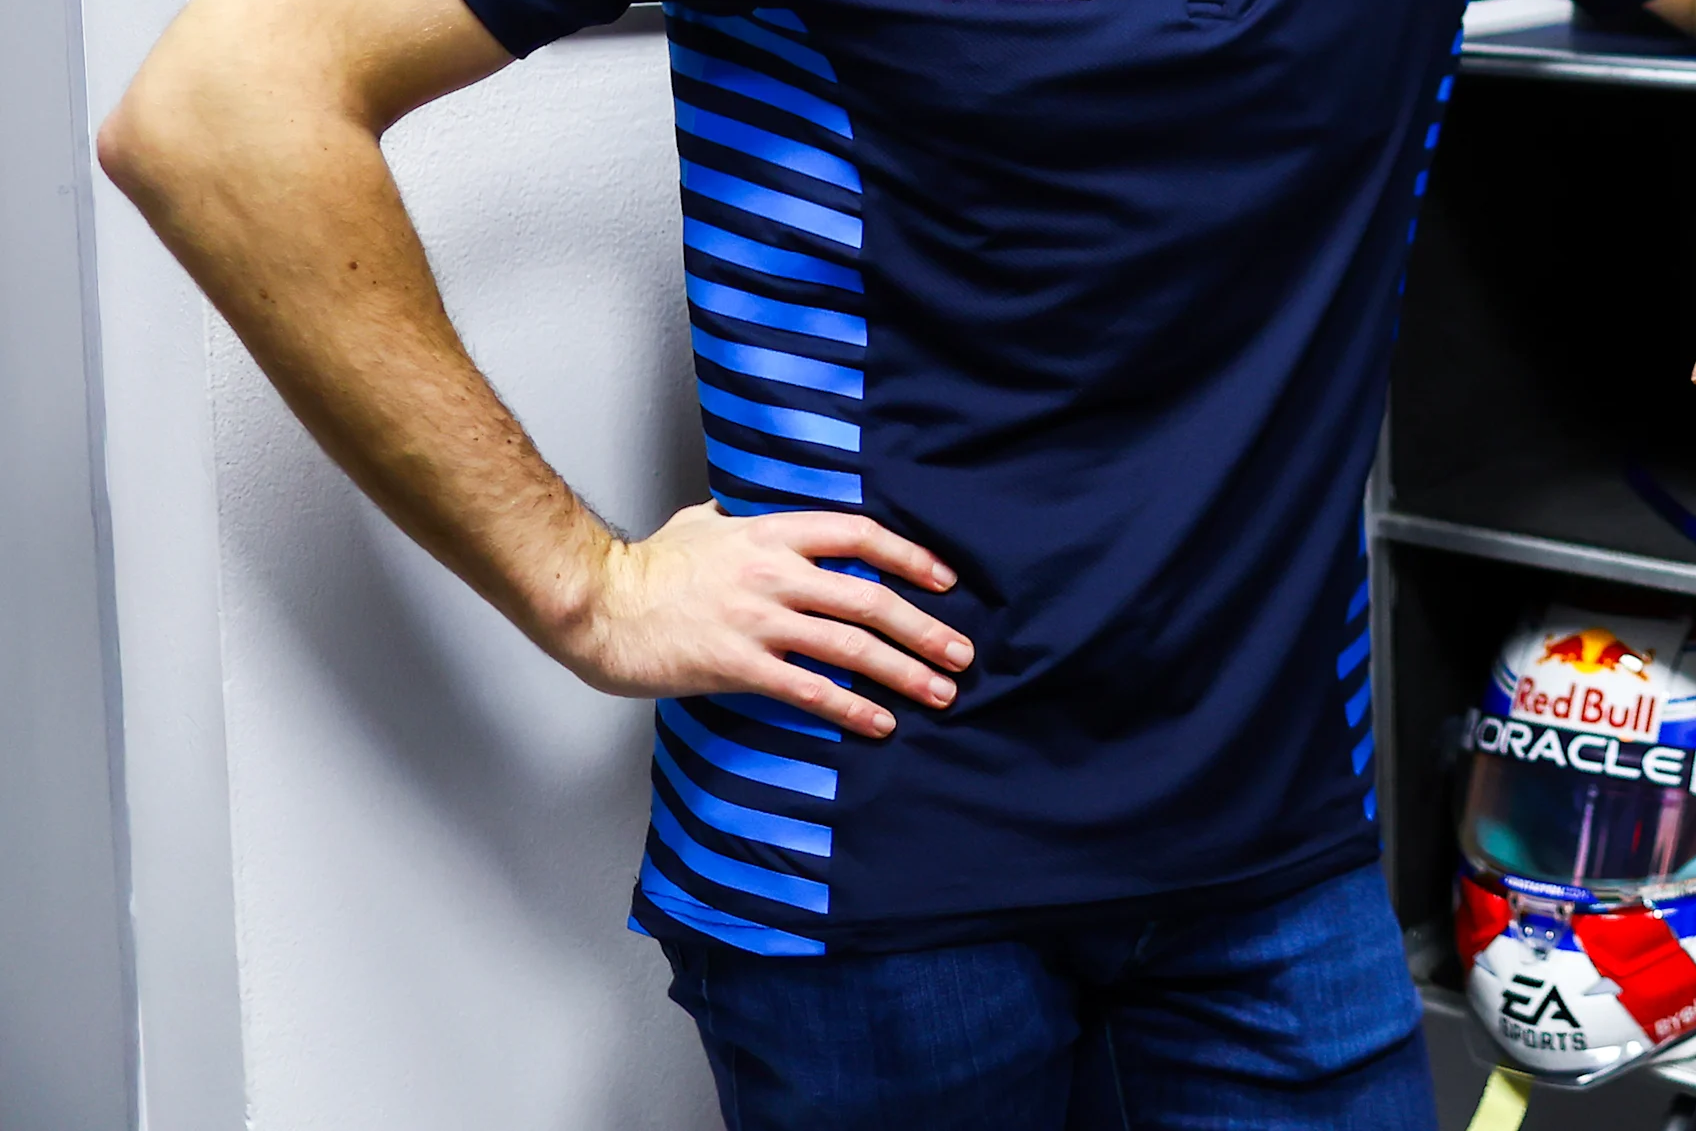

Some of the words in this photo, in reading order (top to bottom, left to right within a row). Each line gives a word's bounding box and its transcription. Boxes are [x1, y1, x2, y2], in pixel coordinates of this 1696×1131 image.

[1514, 675, 1576, 720] Red
[1580, 686, 1657, 733] Bull
[1477, 716, 1687, 785] ORACLE
[1500, 973, 1582, 1029] EA
[1502, 1018, 1589, 1052] SPORTS
